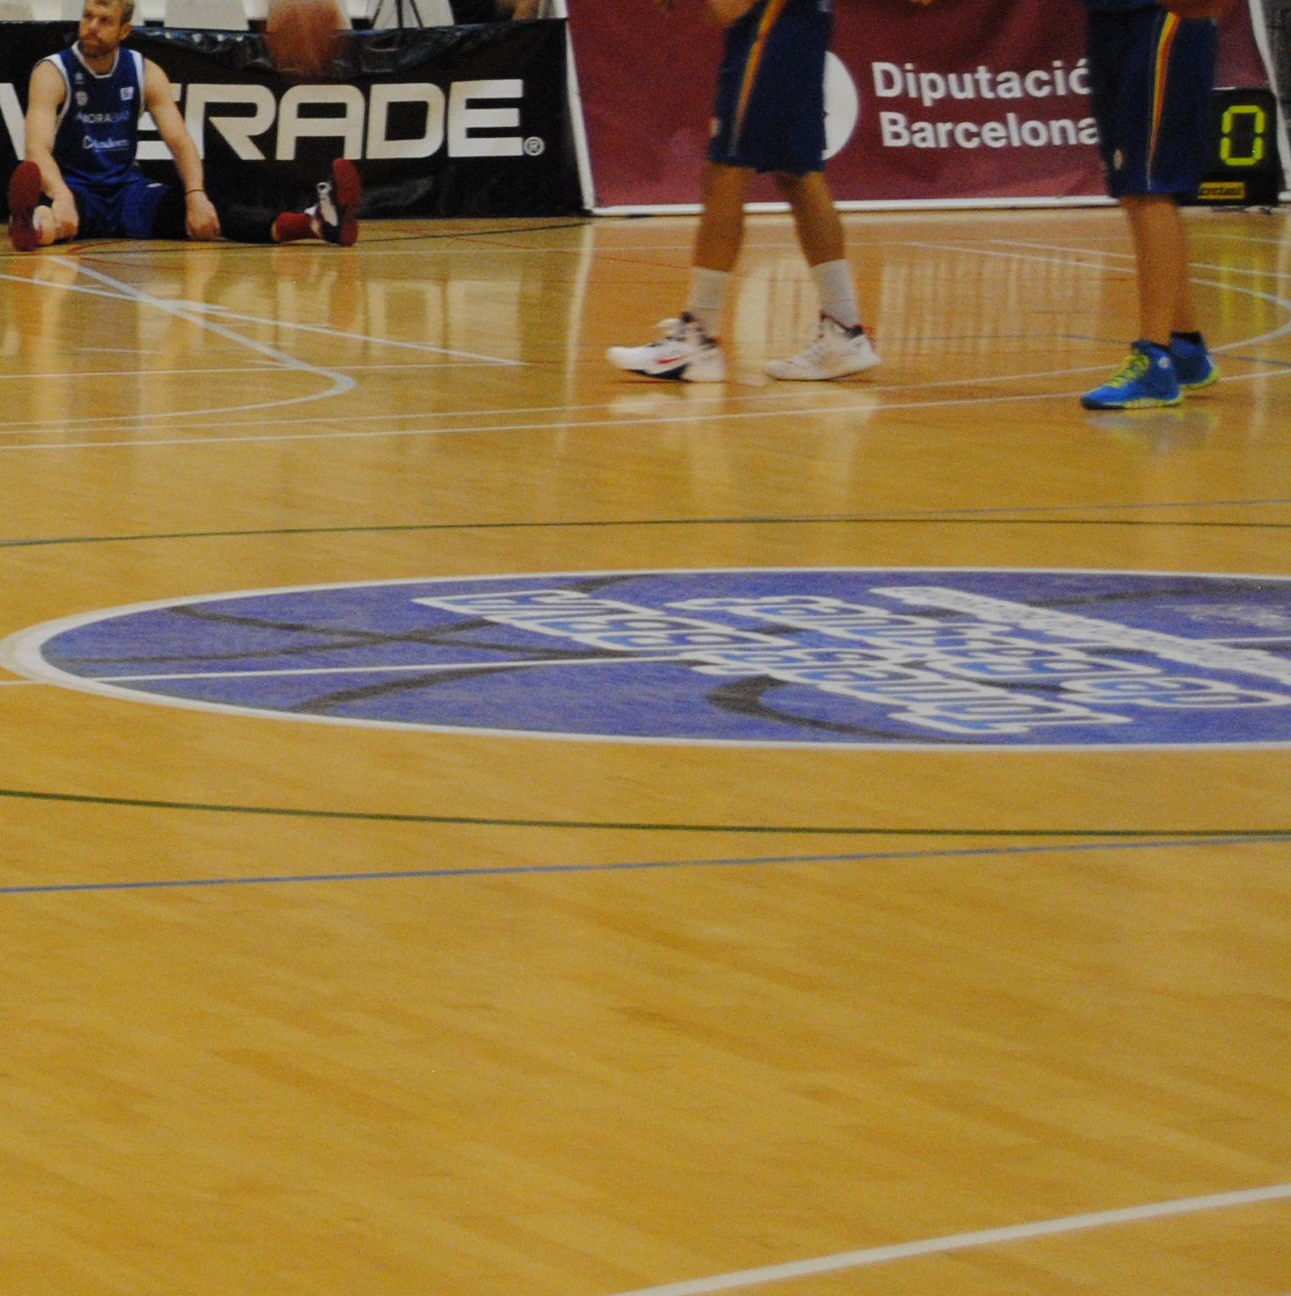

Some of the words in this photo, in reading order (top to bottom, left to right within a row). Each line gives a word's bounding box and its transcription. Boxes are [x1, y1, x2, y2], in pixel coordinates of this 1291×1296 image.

[871, 58, 1091, 107] Diputació
[879, 111, 1100, 149] Barcelona
[410, 590, 799, 650] BBVA
